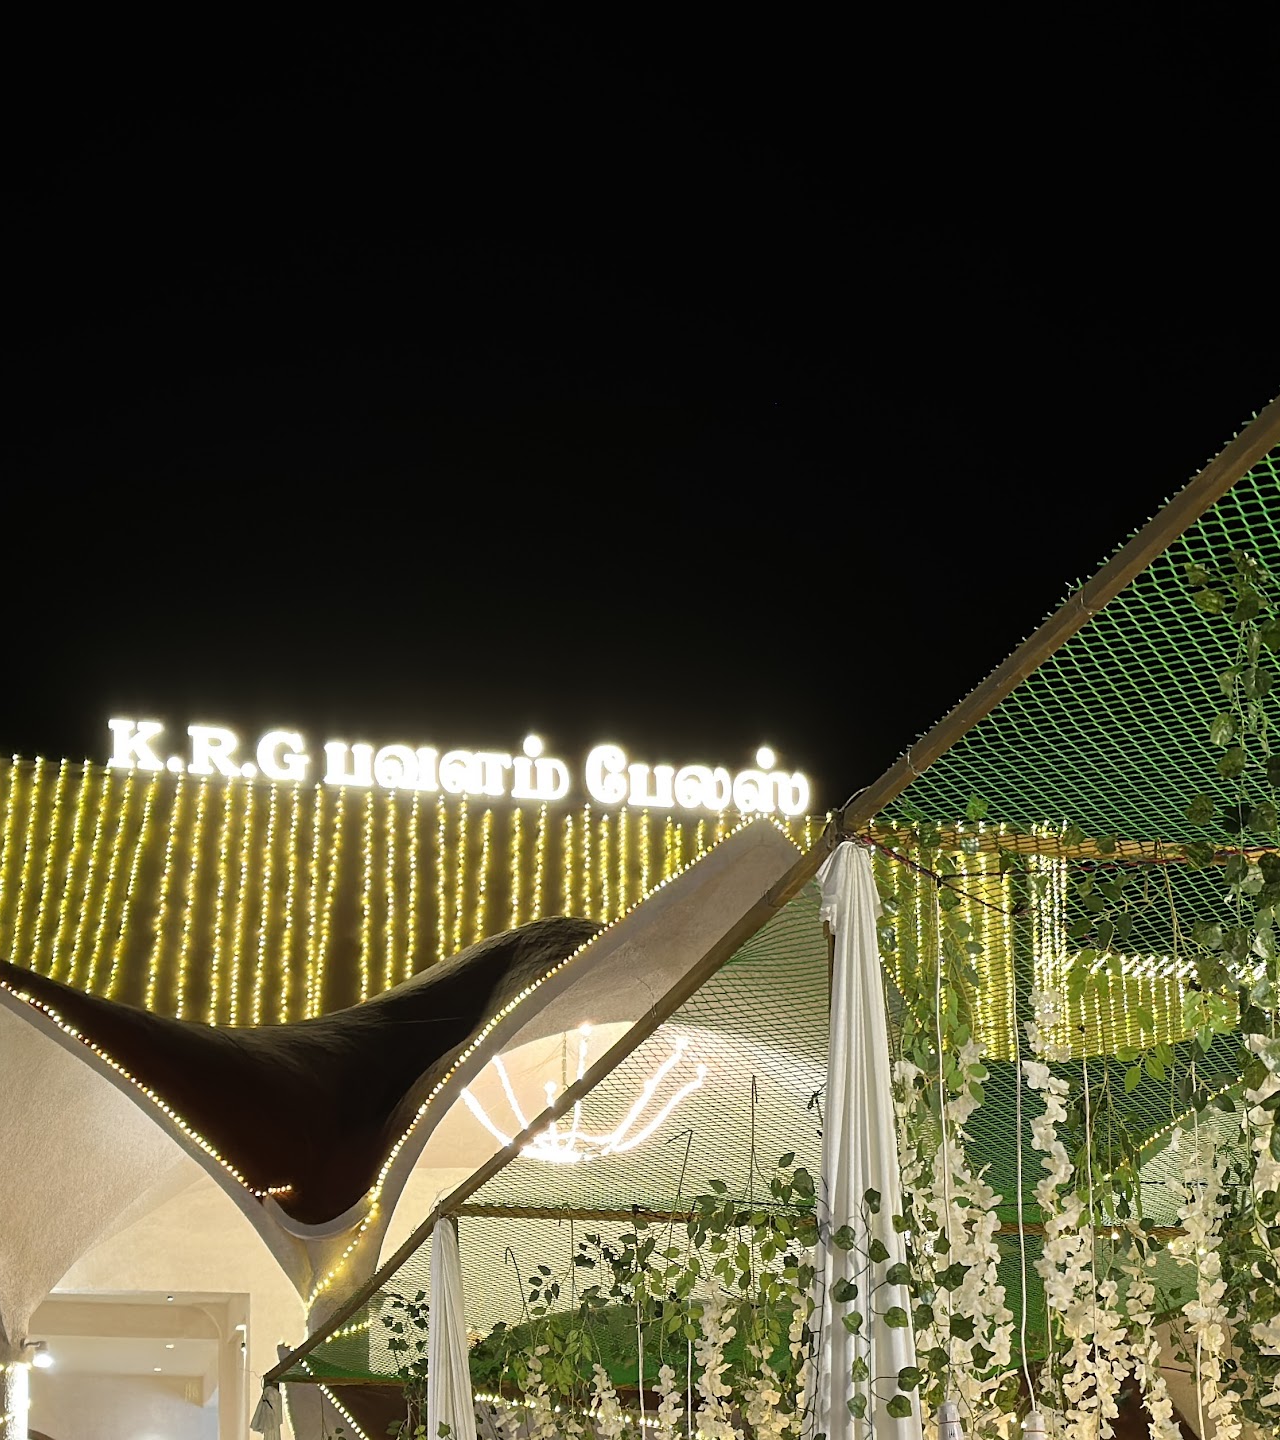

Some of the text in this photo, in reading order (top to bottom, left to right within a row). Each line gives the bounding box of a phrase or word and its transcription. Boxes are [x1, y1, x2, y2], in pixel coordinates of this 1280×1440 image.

[107, 718, 811, 816] K.R.G பவளம் பேலஸ்
